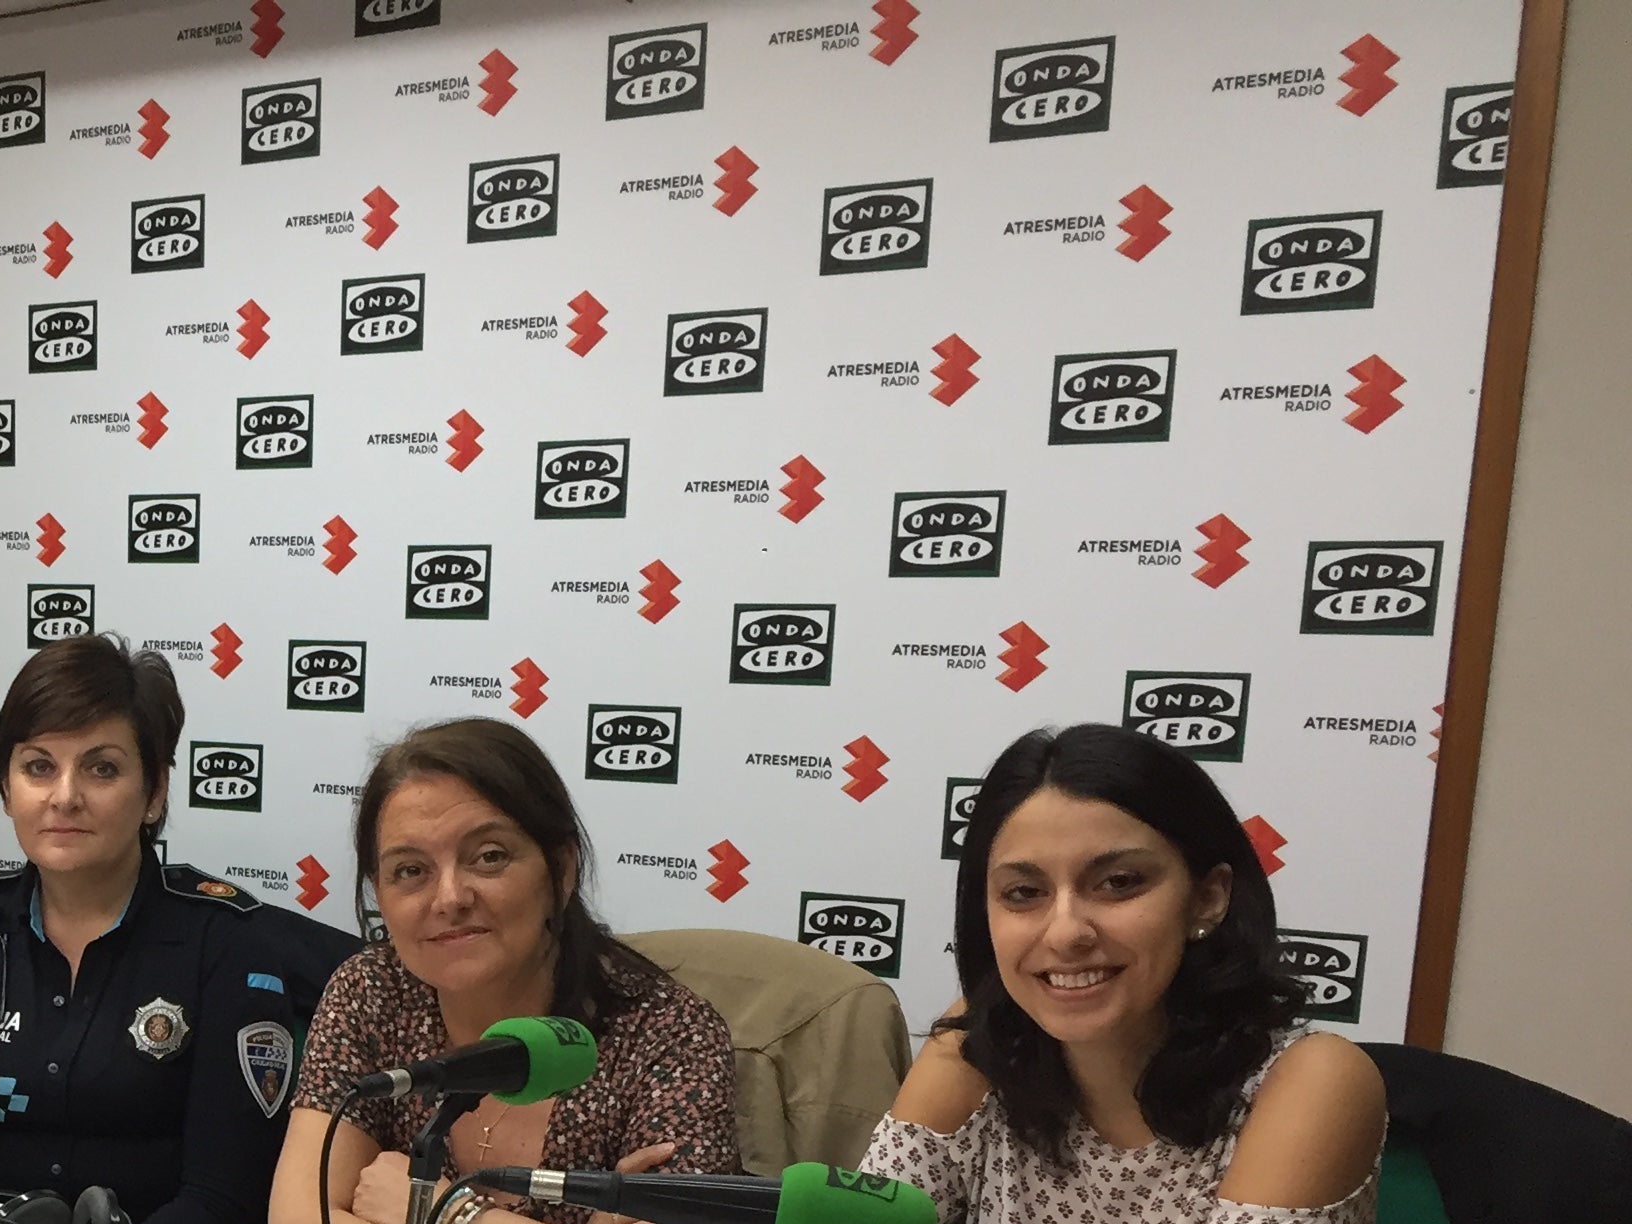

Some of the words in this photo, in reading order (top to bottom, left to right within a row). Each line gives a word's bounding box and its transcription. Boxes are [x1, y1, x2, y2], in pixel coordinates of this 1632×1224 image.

[177, 21, 243, 41] ATRESMEDIA
[768, 21, 859, 46] ATRESMEDIA
[215, 34, 243, 46] RADIO
[822, 36, 859, 51] RADIO
[624, 46, 688, 69] ONDA
[1014, 62, 1091, 86] ONDA
[1212, 67, 1325, 92] ATRESMEDIA
[395, 76, 469, 97] ATRESMEDIA
[626, 76, 687, 97] CERO
[1278, 83, 1325, 99] RADIO
[439, 89, 470, 102] RADIO
[255, 99, 305, 119] ONDA
[1015, 94, 1089, 117] CERO
[69, 123, 131, 140] ATRESMEDIA
[257, 126, 305, 144] CERO
[105, 135, 131, 146] RADIO
[483, 176, 541, 196] ONDA
[620, 174, 703, 194] ATRESMEDIA
[669, 188, 704, 200] RADIO
[285, 211, 354, 228] ATRESMEDIA
[485, 204, 540, 223] CERO
[840, 202, 910, 224] ONDA
[143, 214, 190, 231] ONDA
[326, 224, 354, 234] RADIO
[1003, 215, 1105, 235] ATRESMEDIA
[842, 233, 908, 254] CERO
[1063, 230, 1105, 243] RADIO
[145, 239, 190, 256] CERO
[1267, 236, 1354, 260] ONDA
[13, 254, 37, 264] RADIO
[1268, 270, 1351, 292] CERO
[355, 293, 408, 311] ONDA
[40, 318, 84, 333] ONDA
[166, 322, 229, 336] ATRESMEDIA
[357, 319, 408, 337] CERO
[481, 316, 558, 332] ATRESMEDIA
[203, 334, 229, 343] RADIO
[526, 329, 558, 340] RADIO
[683, 330, 747, 348] ONDA
[42, 341, 84, 357] CERO
[684, 358, 745, 377] CERO
[827, 361, 920, 377] ATRESMEDIA
[881, 375, 919, 387] RADIO
[1072, 373, 1150, 392] ONDA
[1220, 384, 1332, 400] ATRESMEDIA
[1073, 403, 1148, 423] CERO
[1285, 400, 1331, 412] RADIO
[70, 412, 130, 424] ATRESMEDIA
[249, 413, 298, 427] ONDA
[105, 424, 130, 433] RADIO
[251, 437, 297, 453] CERO
[367, 432, 438, 445] ATRESMEDIA
[409, 444, 438, 454] RADIO
[552, 458, 611, 474] ONDA
[554, 484, 609, 501] CERO
[684, 480, 769, 493] ATRESMEDIA
[734, 493, 769, 503] RADIO
[140, 511, 186, 523] ONDA
[911, 511, 983, 528] ONDA
[7, 542, 30, 550] RADIO
[142, 533, 185, 547] CERO
[249, 536, 315, 546] ATRESMEDIA
[1078, 540, 1182, 553] ATRESMEDIA
[288, 548, 315, 556] RADIO
[913, 540, 981, 558] CERO
[1138, 555, 1181, 565] RADIO
[421, 563, 475, 576] ONDA
[1328, 564, 1414, 581] ONDA
[551, 581, 629, 592] ATRESMEDIA
[423, 587, 474, 602] CERO
[597, 594, 629, 604] RADIO
[38, 600, 83, 612] ONDA
[1328, 595, 1411, 614] CERO
[41, 622, 82, 636] CERO
[749, 623, 815, 637] ONDA
[142, 640, 203, 651] ATRESMEDIA
[892, 644, 986, 657] ATRESMEDIA
[178, 653, 203, 661] RADIO
[301, 657, 350, 669] ONDA
[750, 649, 813, 666] CERO
[947, 659, 986, 669] RADIO
[302, 680, 349, 694] CERO
[430, 676, 502, 688] ATRESMEDIA
[472, 689, 502, 699] RADIO
[1145, 693, 1224, 708] ONDA
[603, 723, 662, 736] ONDA
[1303, 717, 1416, 733] ATRESMEDIA
[1369, 734, 1416, 746] RADIO
[604, 748, 660, 764] CERO
[745, 753, 832, 768] ATRESMEDIA
[201, 758, 247, 770] ONDA
[796, 769, 832, 780] RADIO
[203, 780, 247, 795] CERO
[617, 853, 697, 870] ATRESMEDIA
[225, 866, 288, 881] ATRESMEDIA
[664, 869, 697, 880] RADIO
[262, 881, 289, 891] RADIO
[817, 913, 884, 929] ONDA
